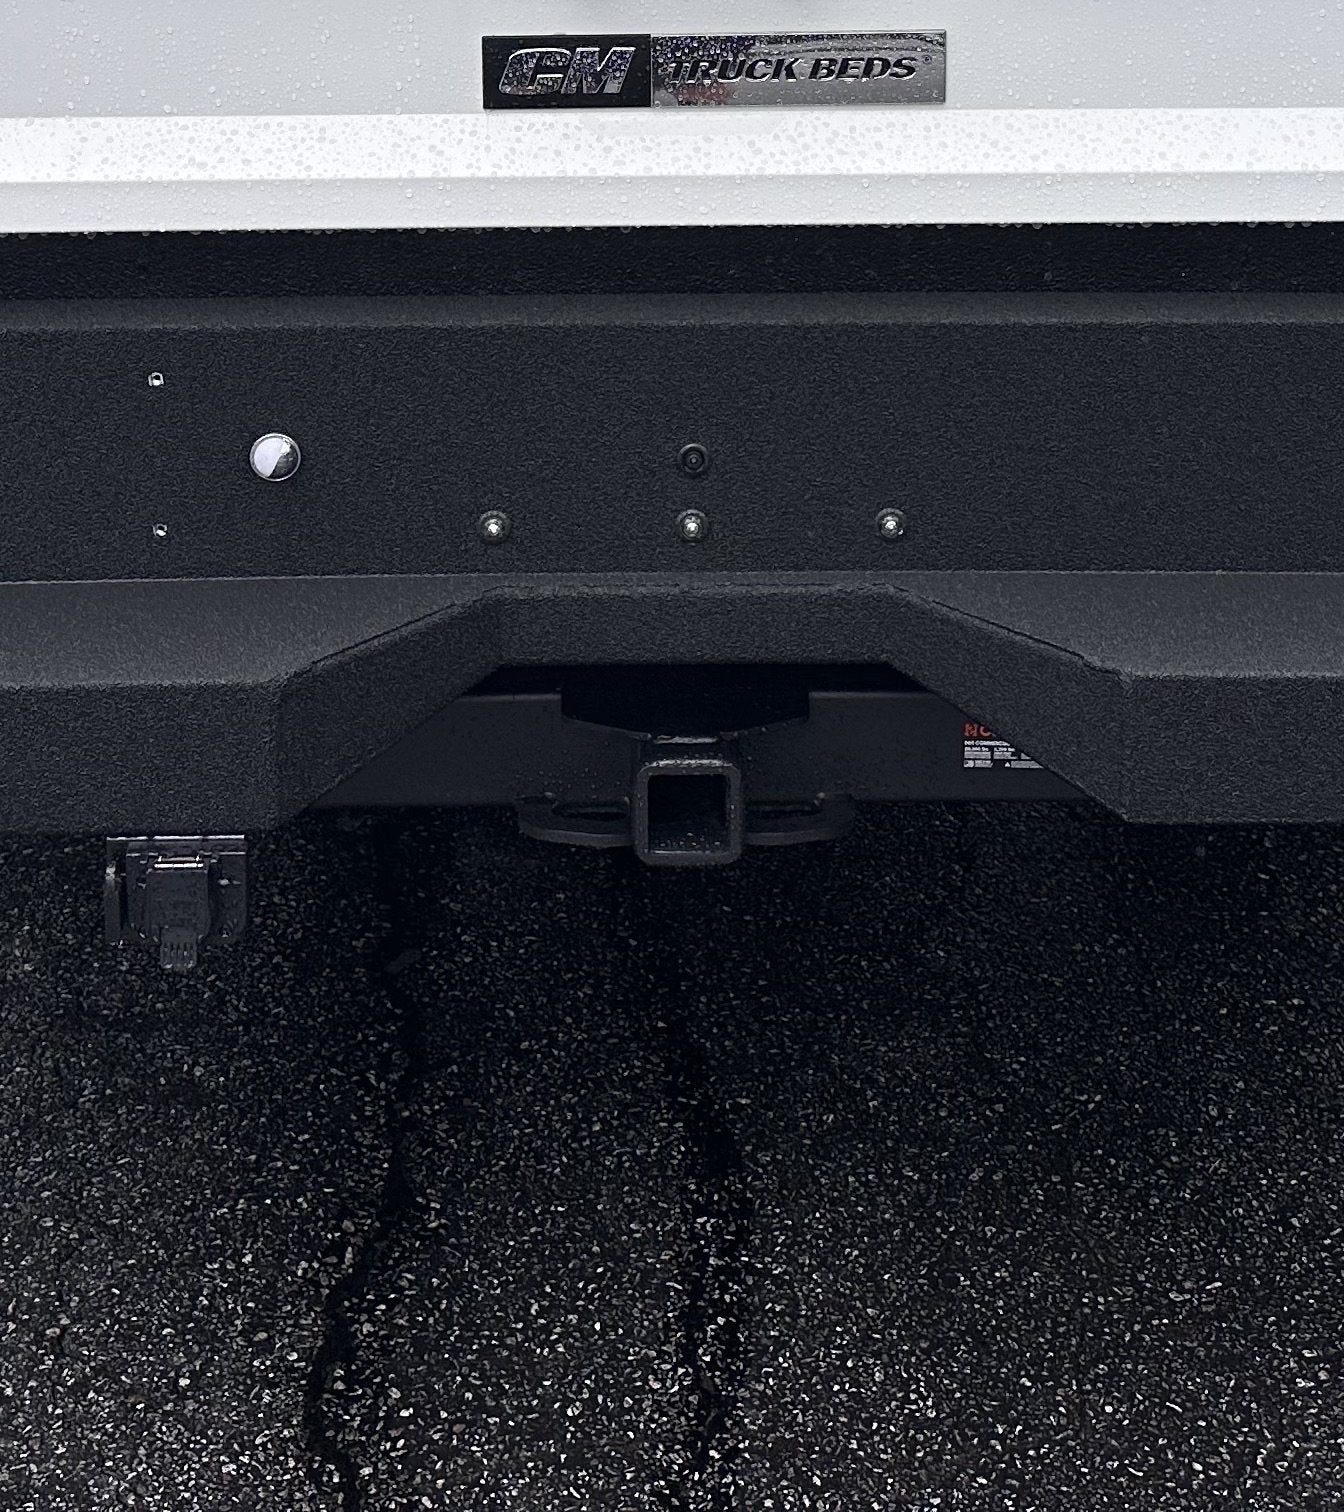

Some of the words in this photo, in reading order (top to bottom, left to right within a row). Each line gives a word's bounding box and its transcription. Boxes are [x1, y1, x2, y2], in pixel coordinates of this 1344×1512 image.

[498, 46, 637, 94] CM
[668, 56, 806, 83] TRUCK
[808, 57, 918, 83] BEDS
